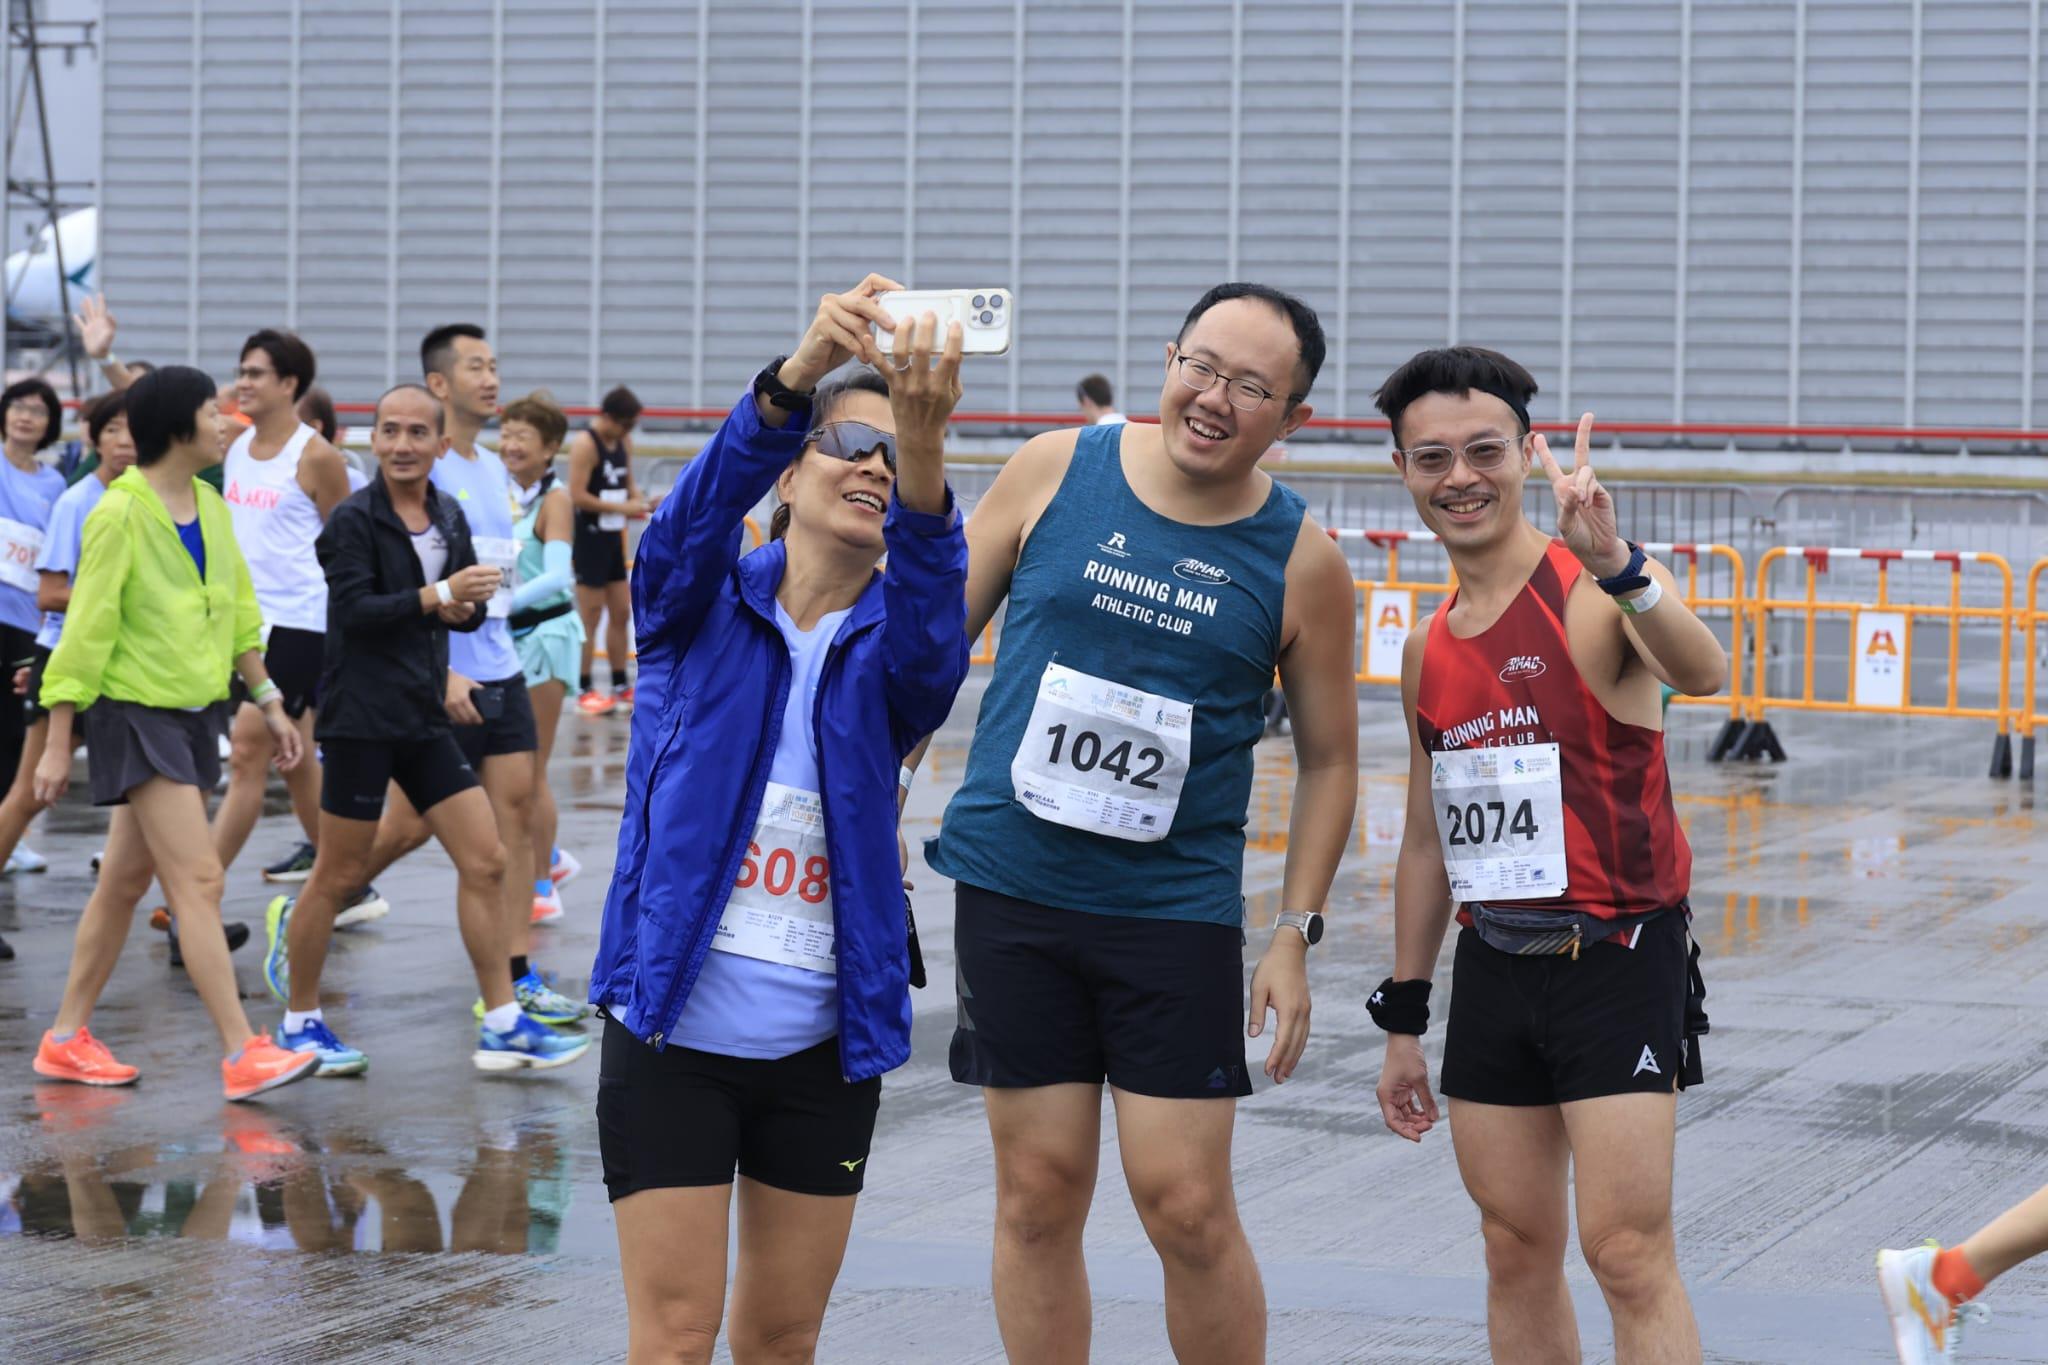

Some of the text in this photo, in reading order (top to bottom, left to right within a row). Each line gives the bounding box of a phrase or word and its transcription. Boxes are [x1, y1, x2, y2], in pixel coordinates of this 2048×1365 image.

[1083, 559, 1218, 617] RUNNING MAN
[1091, 593, 1193, 636] ATHLETIC CLUB
[1499, 705, 1540, 729] MAN
[1499, 732, 1535, 747] CLUB
[1046, 722, 1165, 791] 1042
[1446, 798, 1539, 847] 2074
